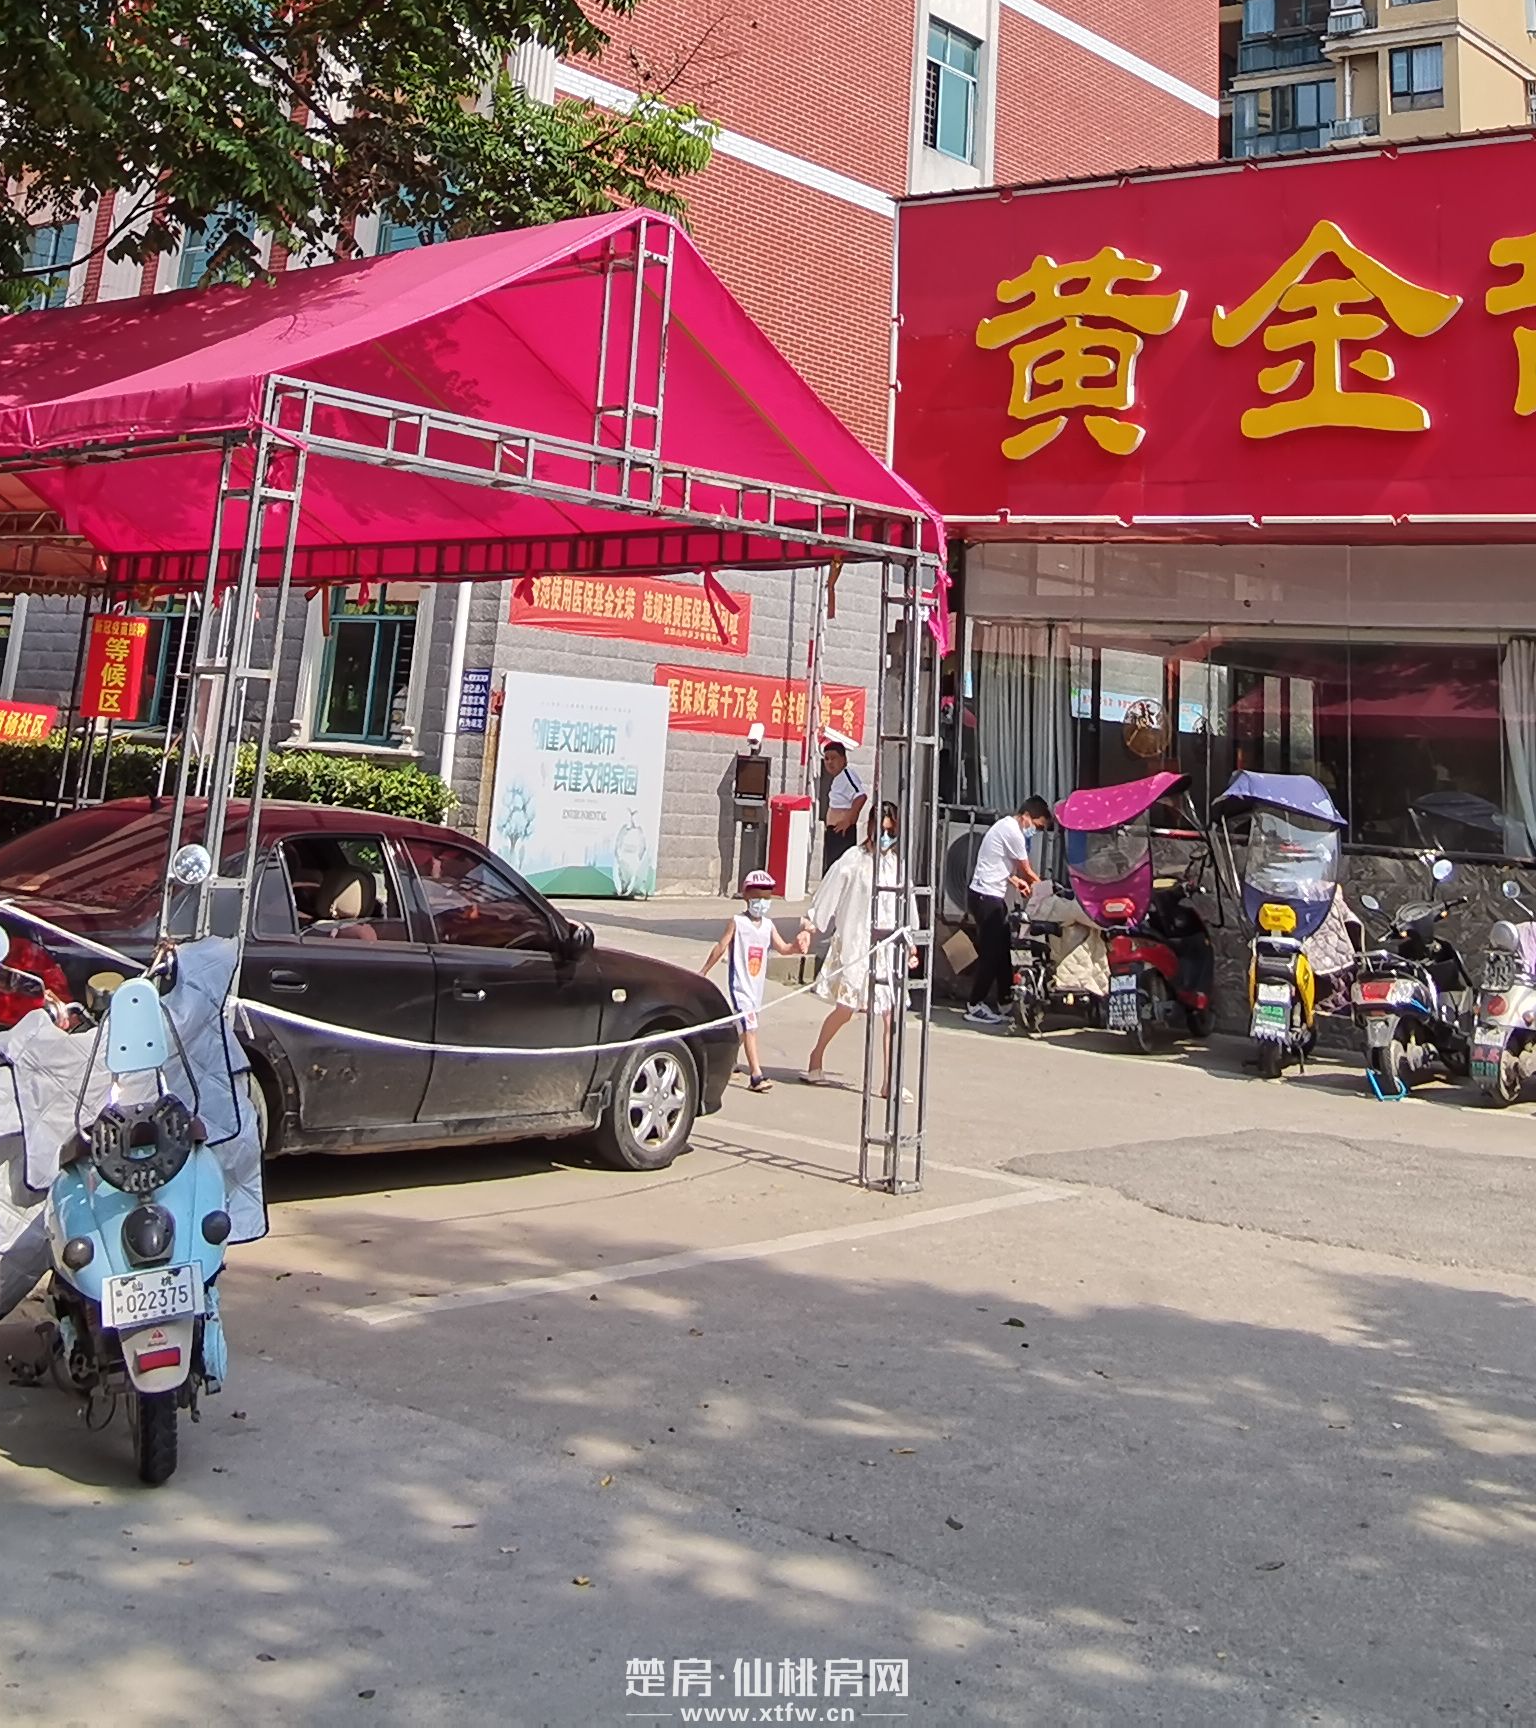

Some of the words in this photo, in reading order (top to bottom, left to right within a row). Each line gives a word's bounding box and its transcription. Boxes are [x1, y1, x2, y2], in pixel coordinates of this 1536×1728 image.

[98, 637, 131, 712] 等候区
[668, 678, 759, 721] 医保政策千万条
[771, 689, 854, 730] 合法使第一条
[532, 717, 617, 756] 创建文明城市
[553, 759, 639, 796] 共建文明家园
[127, 1285, 188, 1313] 022375
